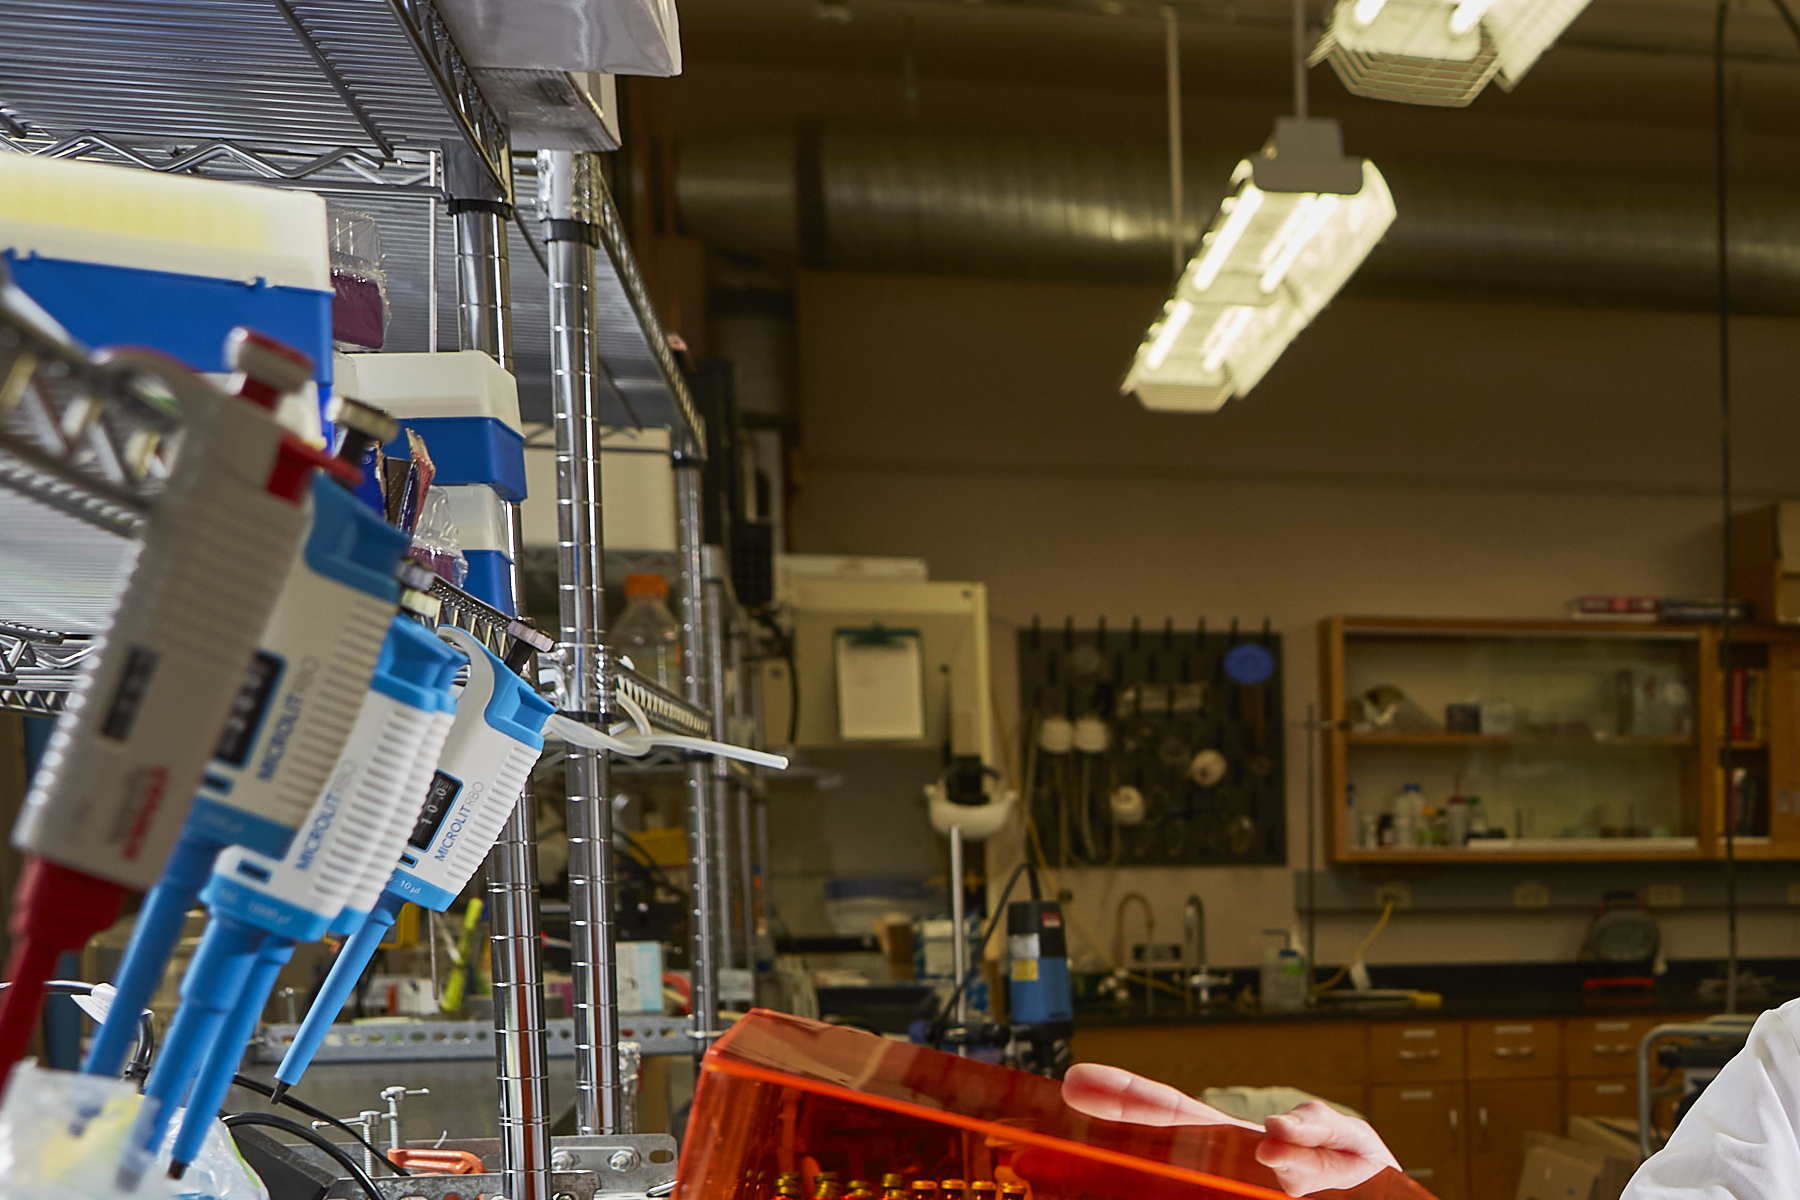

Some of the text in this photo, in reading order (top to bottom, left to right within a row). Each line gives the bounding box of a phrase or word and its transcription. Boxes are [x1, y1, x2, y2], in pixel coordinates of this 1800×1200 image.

[295, 791, 341, 871] MICROLIT
[434, 781, 484, 861] MICROLIT RBO
